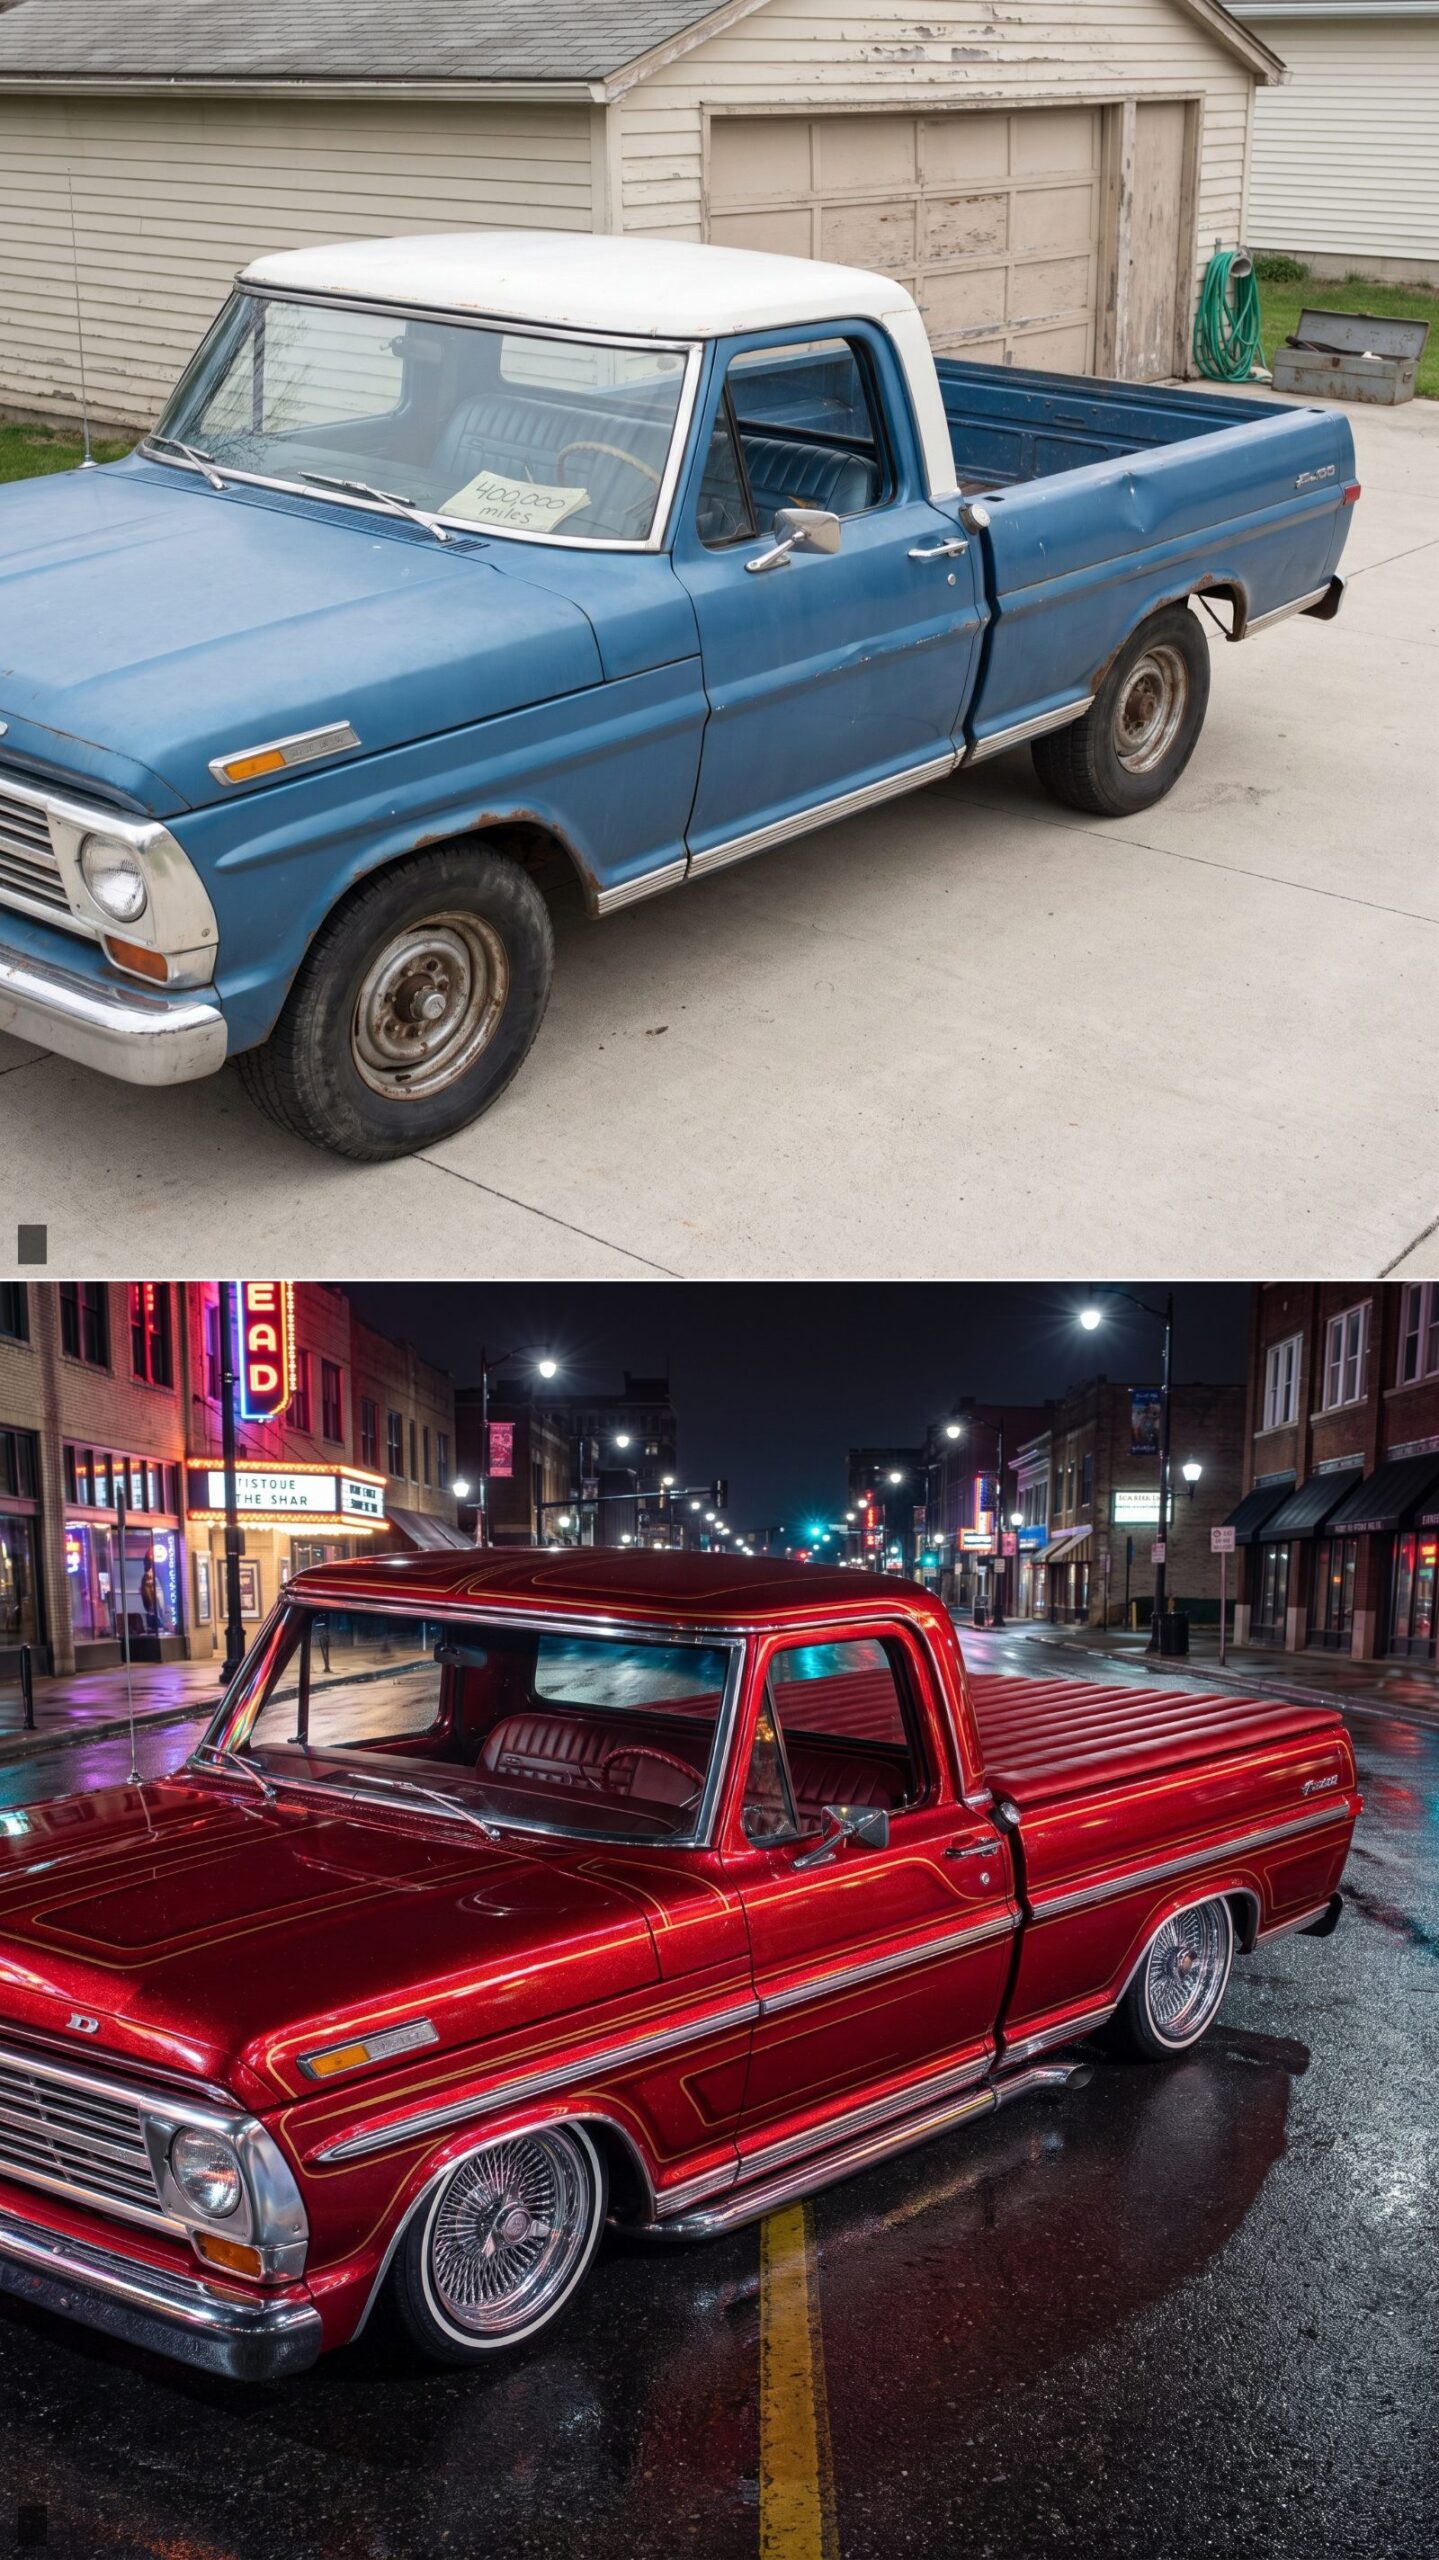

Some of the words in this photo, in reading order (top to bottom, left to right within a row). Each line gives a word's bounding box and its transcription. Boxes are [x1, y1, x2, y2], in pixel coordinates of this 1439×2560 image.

[475, 481, 566, 509] 400,000
[479, 506, 534, 524] miles
[247, 1282, 278, 1392] EAD
[235, 1493, 262, 1504] THE
[271, 1495, 308, 1506] SHAR
